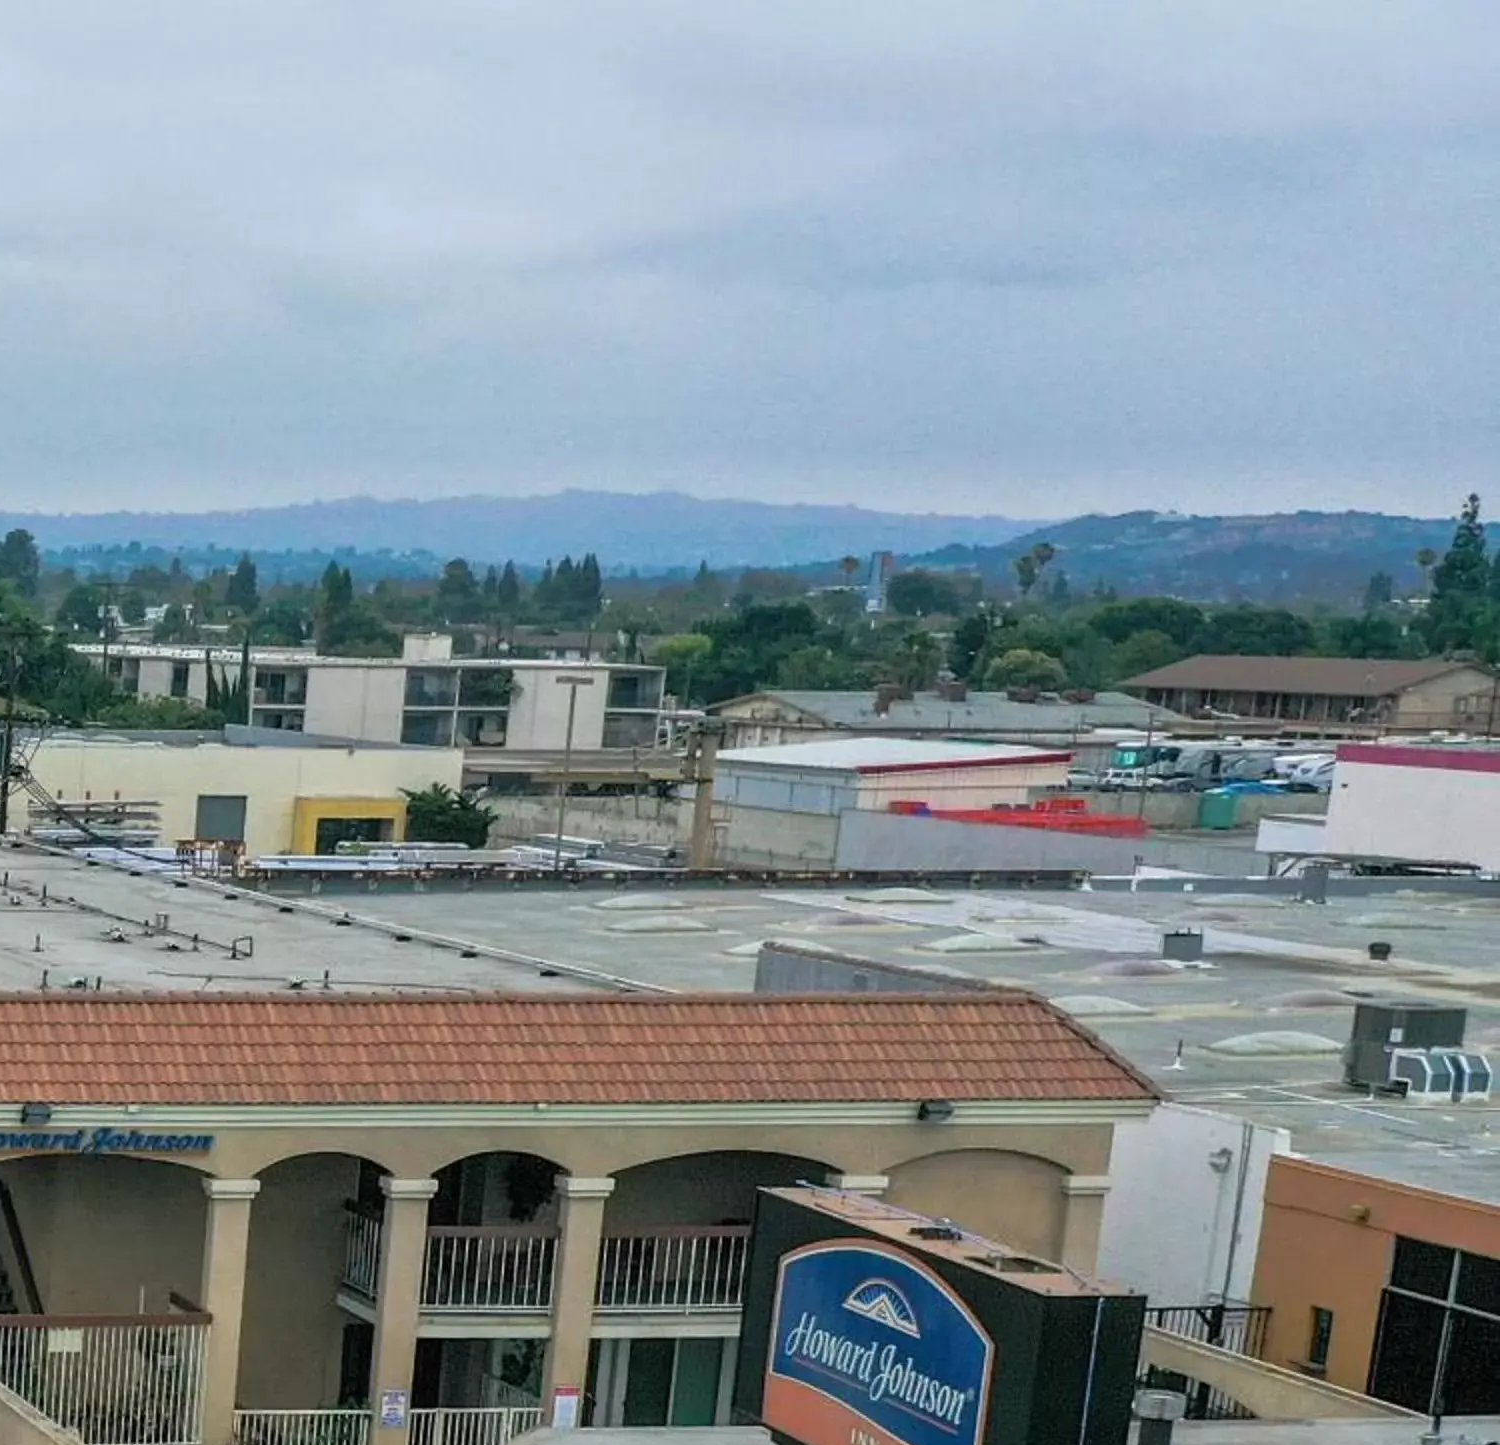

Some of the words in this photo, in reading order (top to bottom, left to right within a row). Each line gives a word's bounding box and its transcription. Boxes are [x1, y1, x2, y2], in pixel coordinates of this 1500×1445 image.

[79, 1126, 214, 1158] Johnson
[785, 1312, 876, 1383] Howard
[870, 1344, 966, 1426] Johnson
